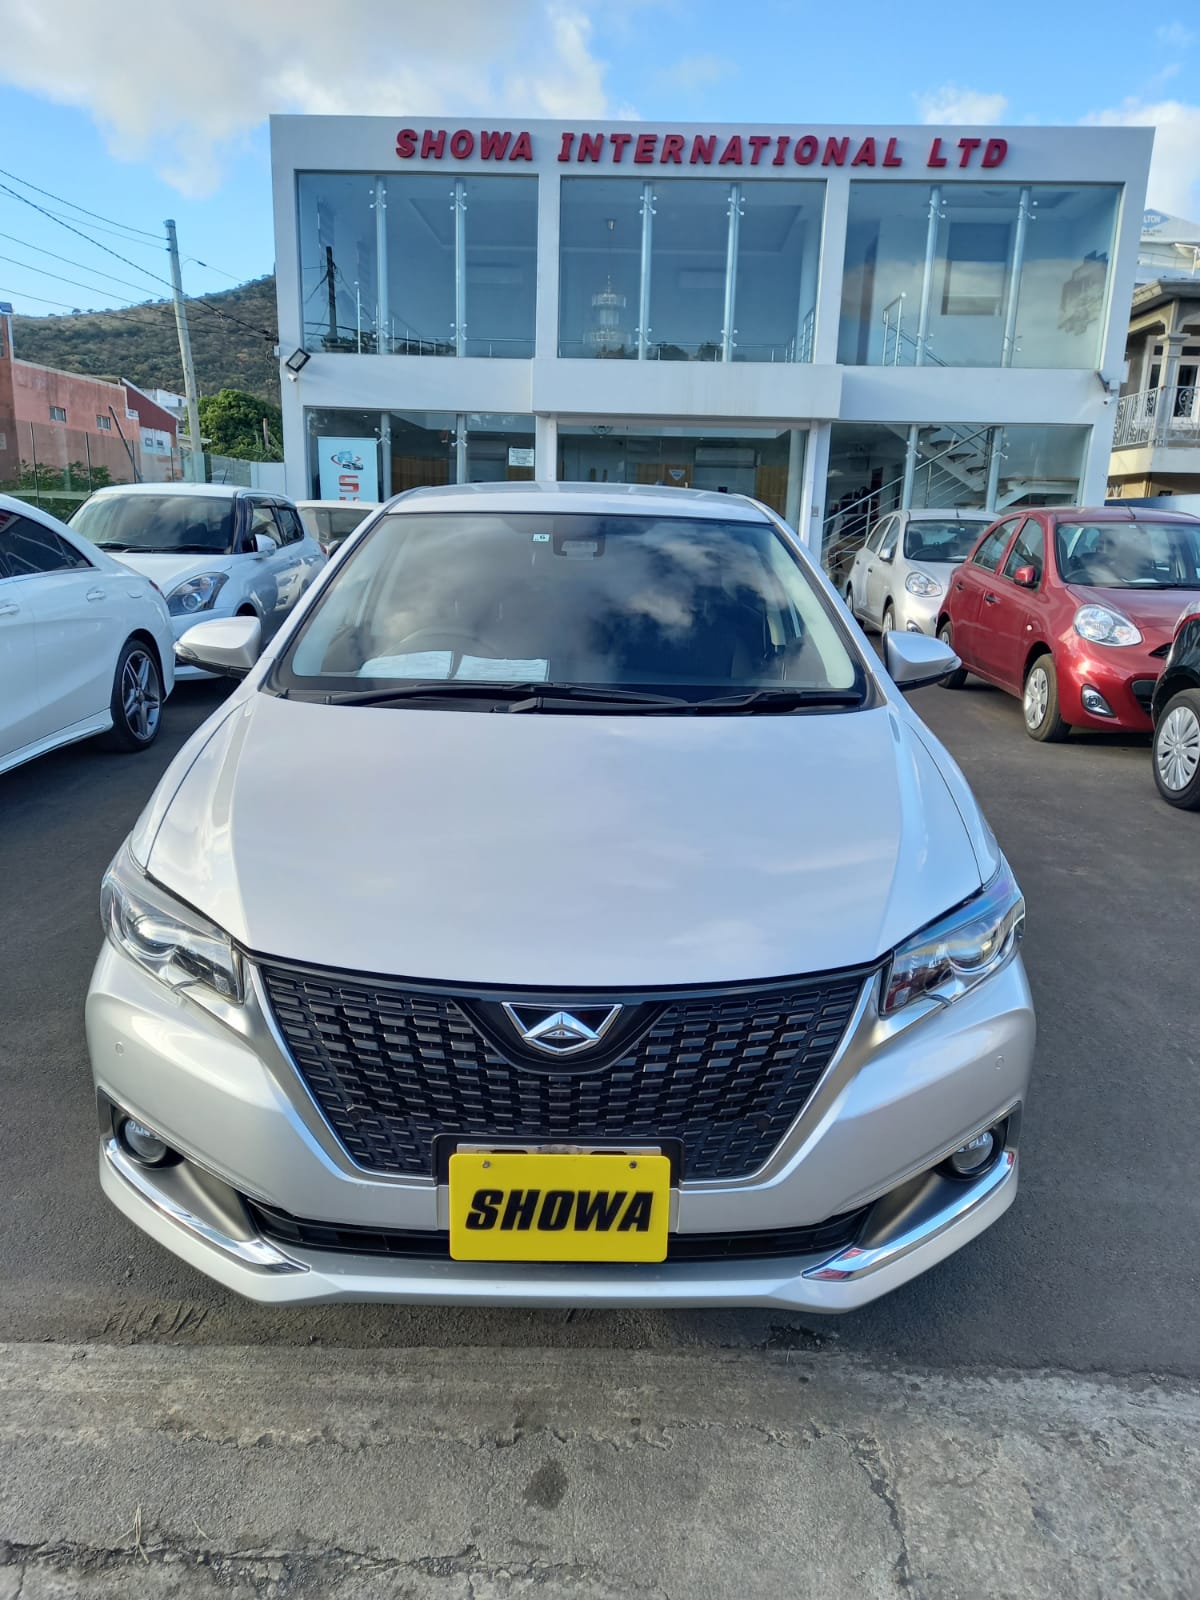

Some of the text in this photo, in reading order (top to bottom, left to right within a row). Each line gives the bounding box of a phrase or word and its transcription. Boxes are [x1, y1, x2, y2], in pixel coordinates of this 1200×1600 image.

[395, 129, 1009, 168] SHOWA INTERNATIONAL LTD
[465, 1188, 654, 1232] SHOWA
